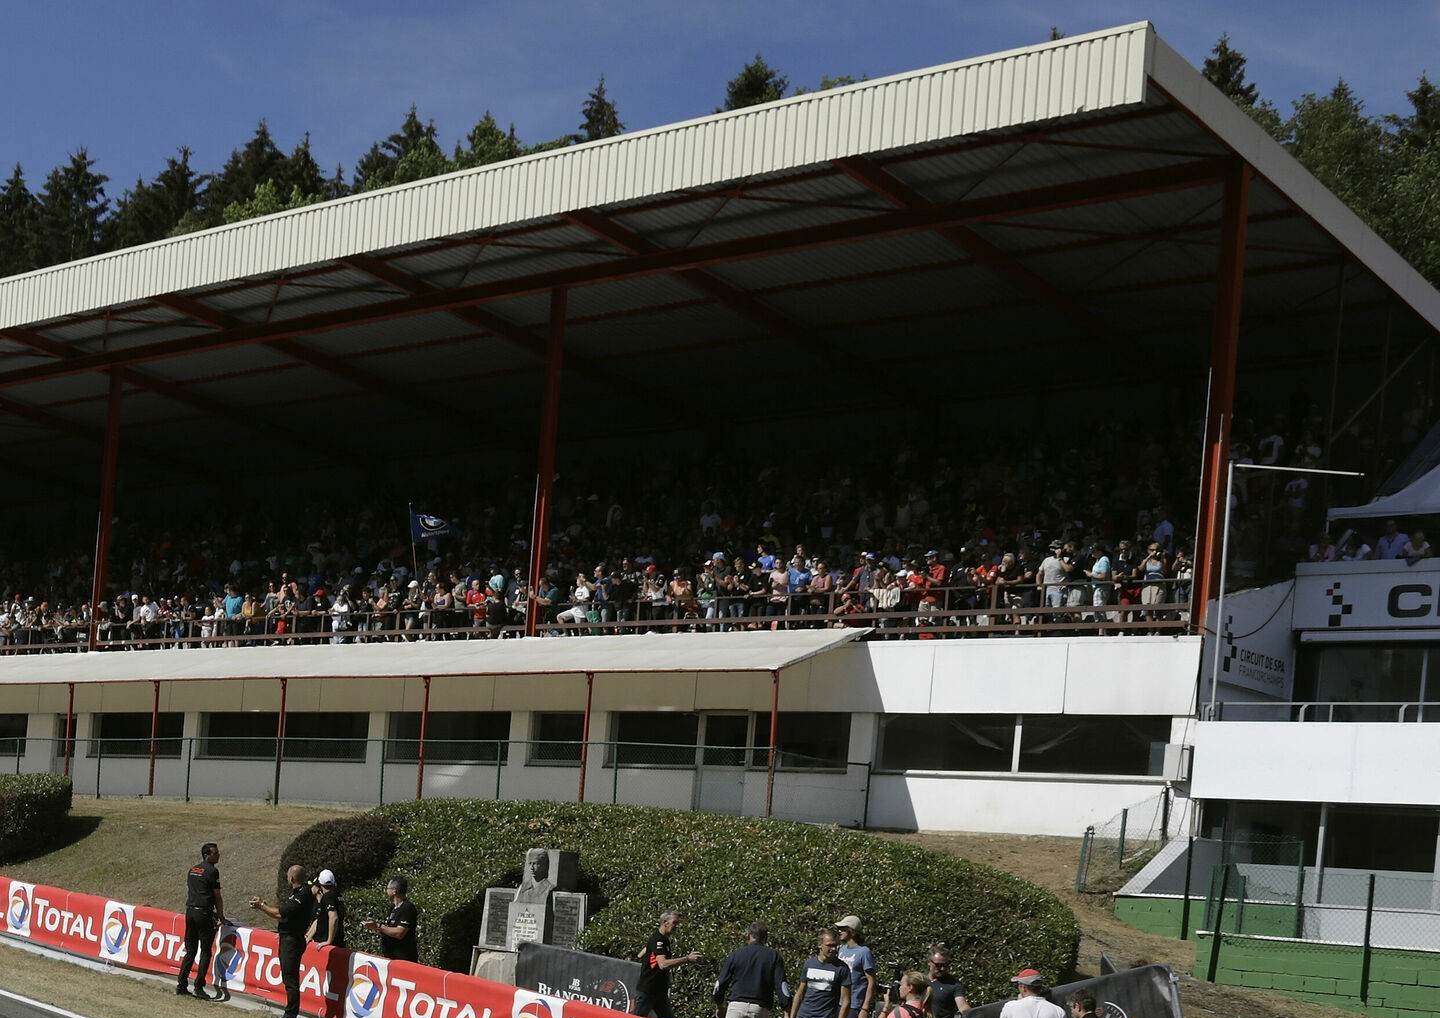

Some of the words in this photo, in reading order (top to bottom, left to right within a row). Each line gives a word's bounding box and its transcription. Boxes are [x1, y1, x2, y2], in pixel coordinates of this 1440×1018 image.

[1241, 649, 1265, 667] CIRCUIT
[34, 898, 98, 942] TOTAL
[251, 945, 339, 1001] TOAL
[538, 982, 614, 1009] BLANCPAIN
